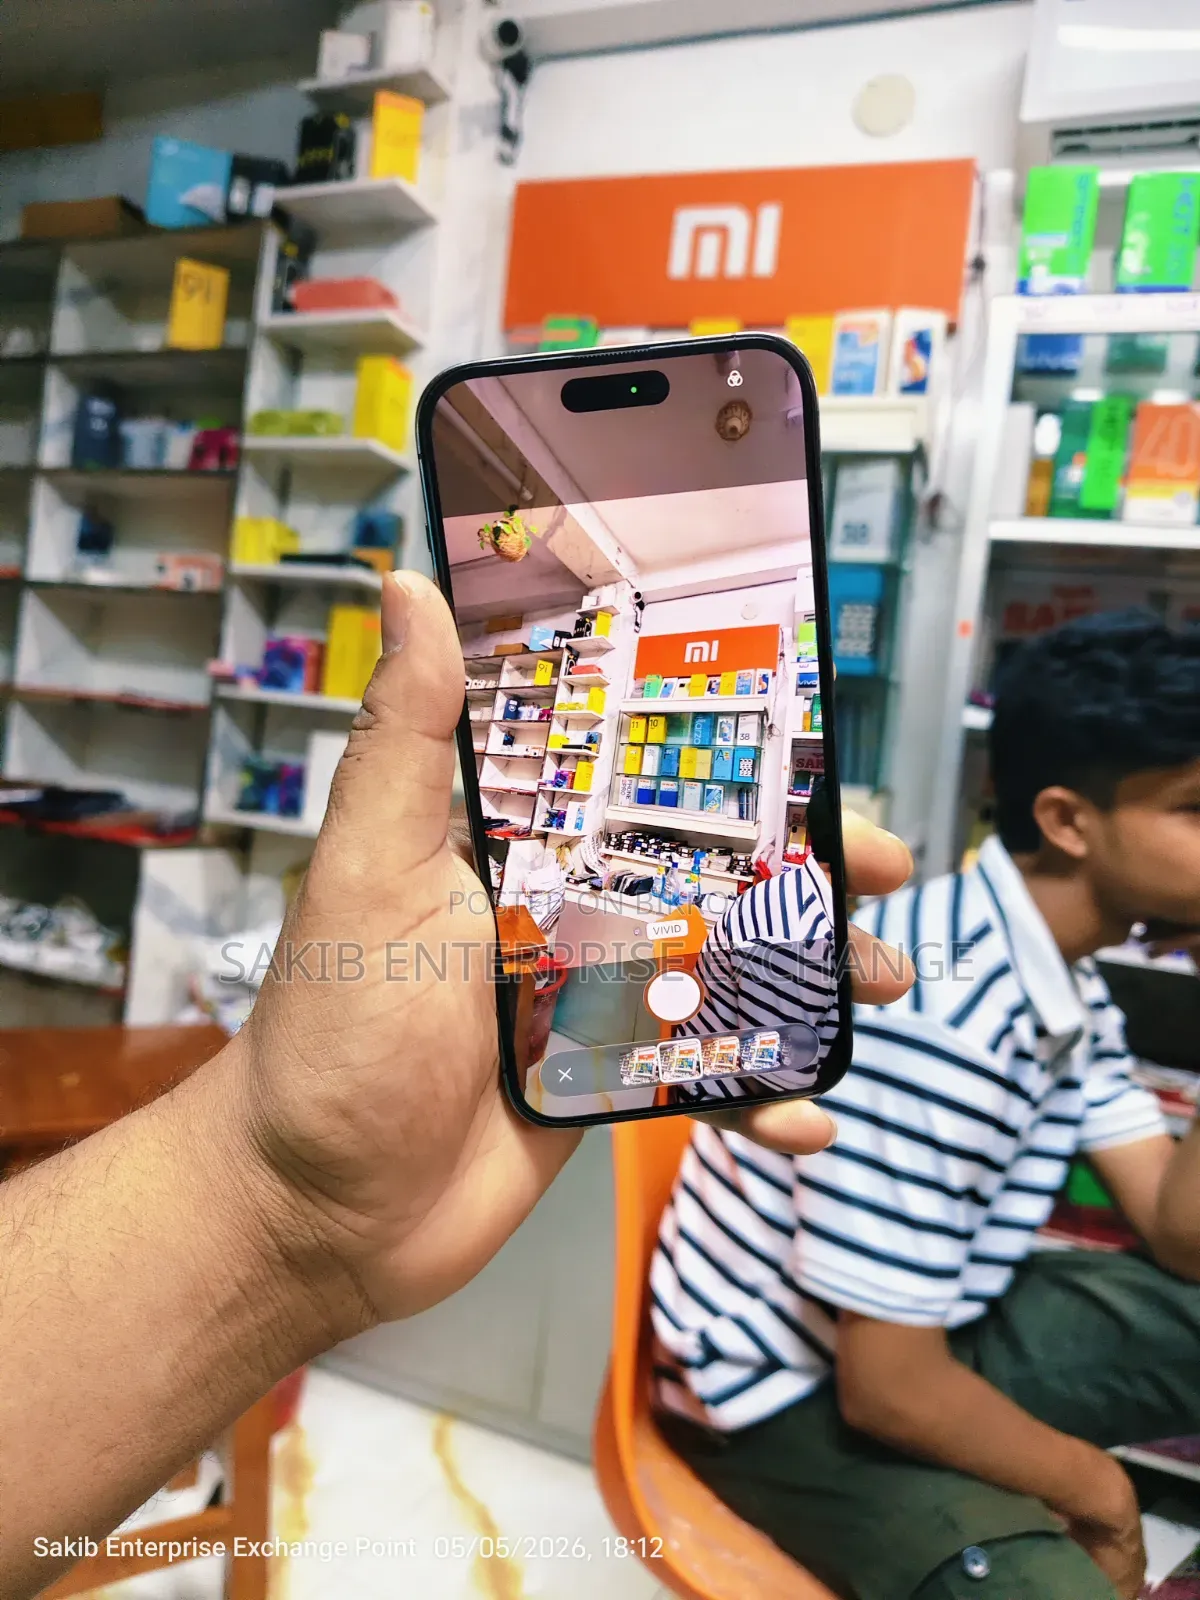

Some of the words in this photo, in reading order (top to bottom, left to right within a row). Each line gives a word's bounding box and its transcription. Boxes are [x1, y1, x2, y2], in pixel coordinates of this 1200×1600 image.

[649, 719, 658, 727] 10
[739, 733, 750, 741] 38
[652, 924, 682, 936] VIVID
